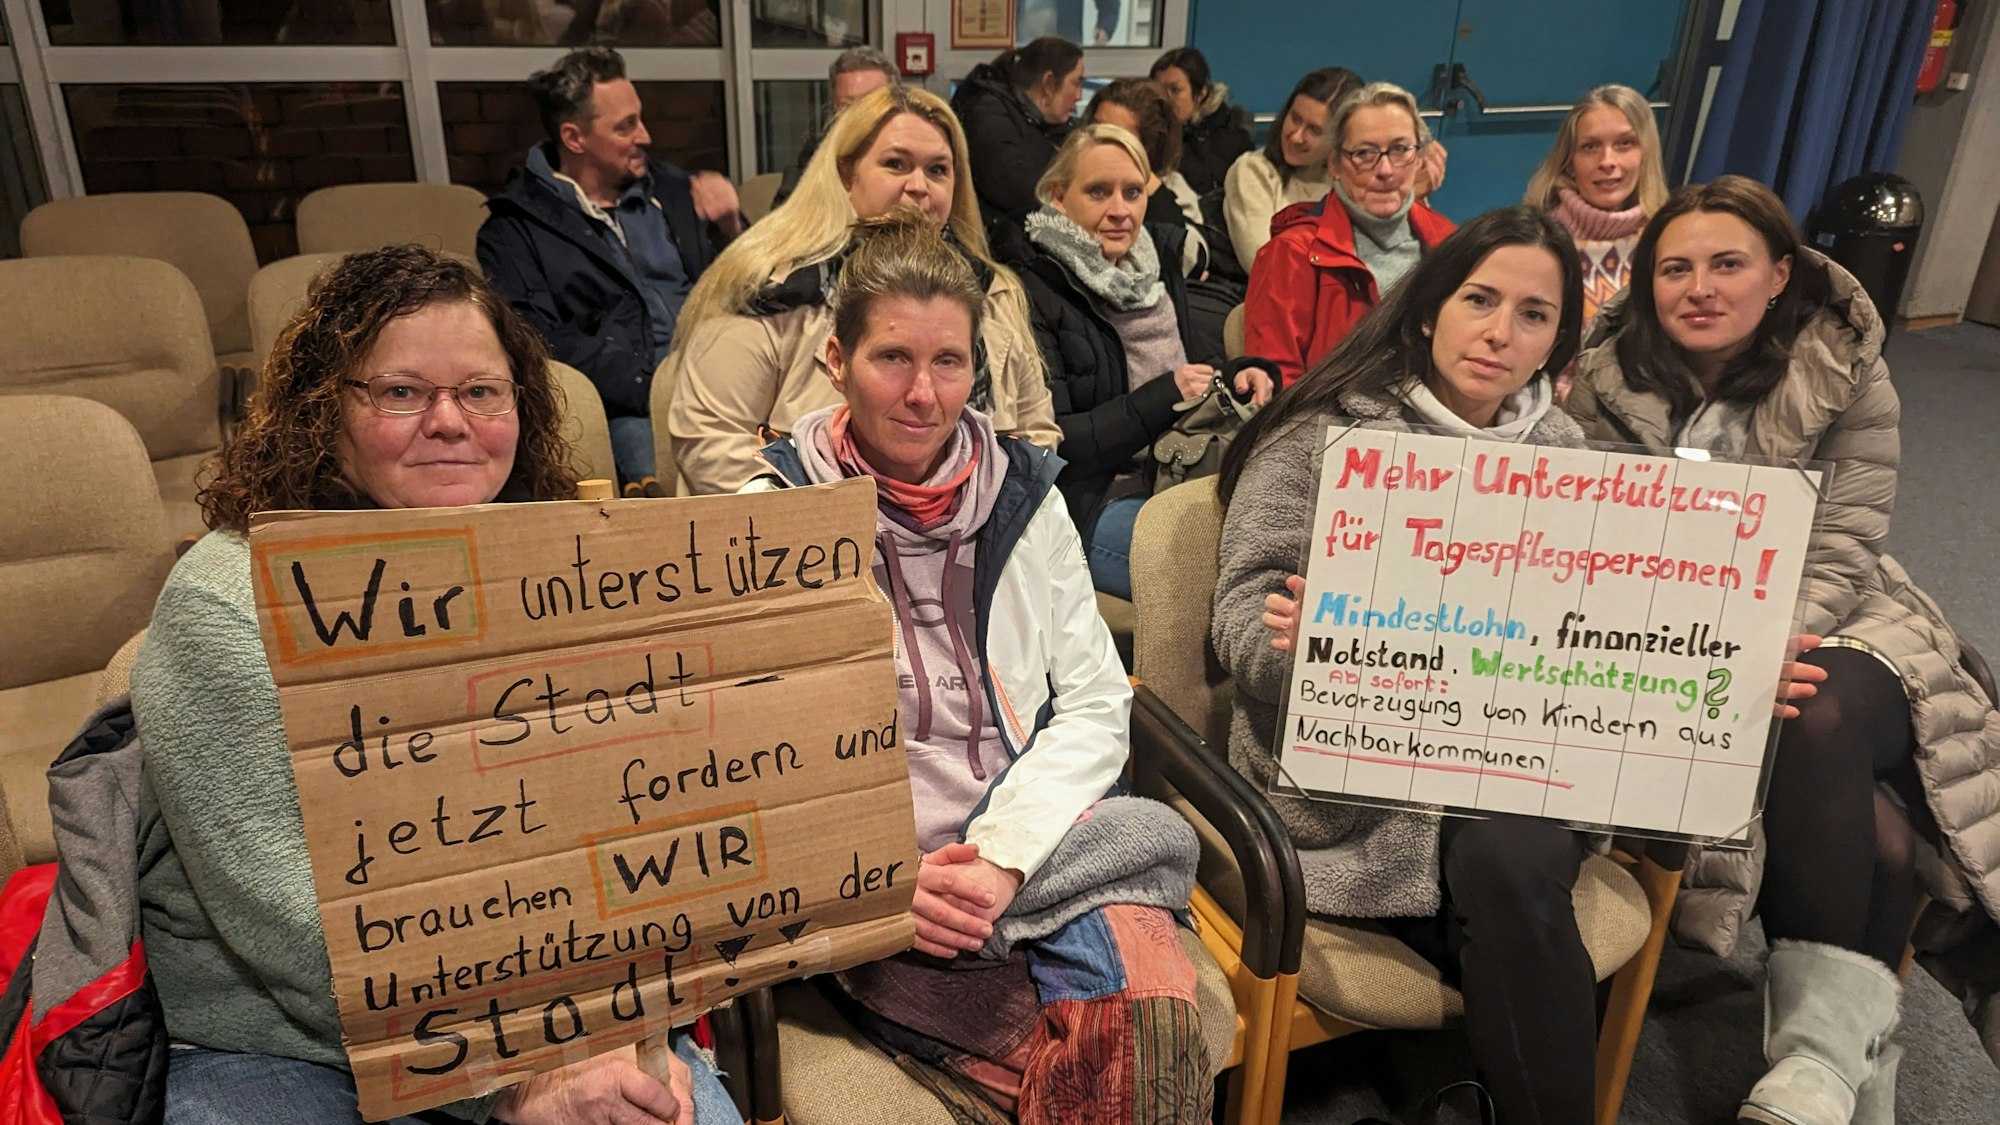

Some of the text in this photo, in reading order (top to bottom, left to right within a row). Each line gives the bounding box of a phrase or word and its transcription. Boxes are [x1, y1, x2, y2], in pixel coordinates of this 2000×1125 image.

[1325, 509, 1381, 557] für
[1335, 447, 1767, 540] Mehr Unterstützung
[291, 517, 862, 646] Wir unterstützen
[1312, 591, 1742, 659] Mindestlohn, finanzieller
[332, 705, 436, 777] die
[479, 652, 695, 746] Stadt
[1300, 680, 1733, 750] Bevorzugung von Kindern aus
[1370, 671, 1449, 694] sofort:
[345, 709, 897, 885] jetzt fordern und
[355, 825, 753, 953] brauchen WIR
[364, 852, 904, 1012] Unterstützung von der
